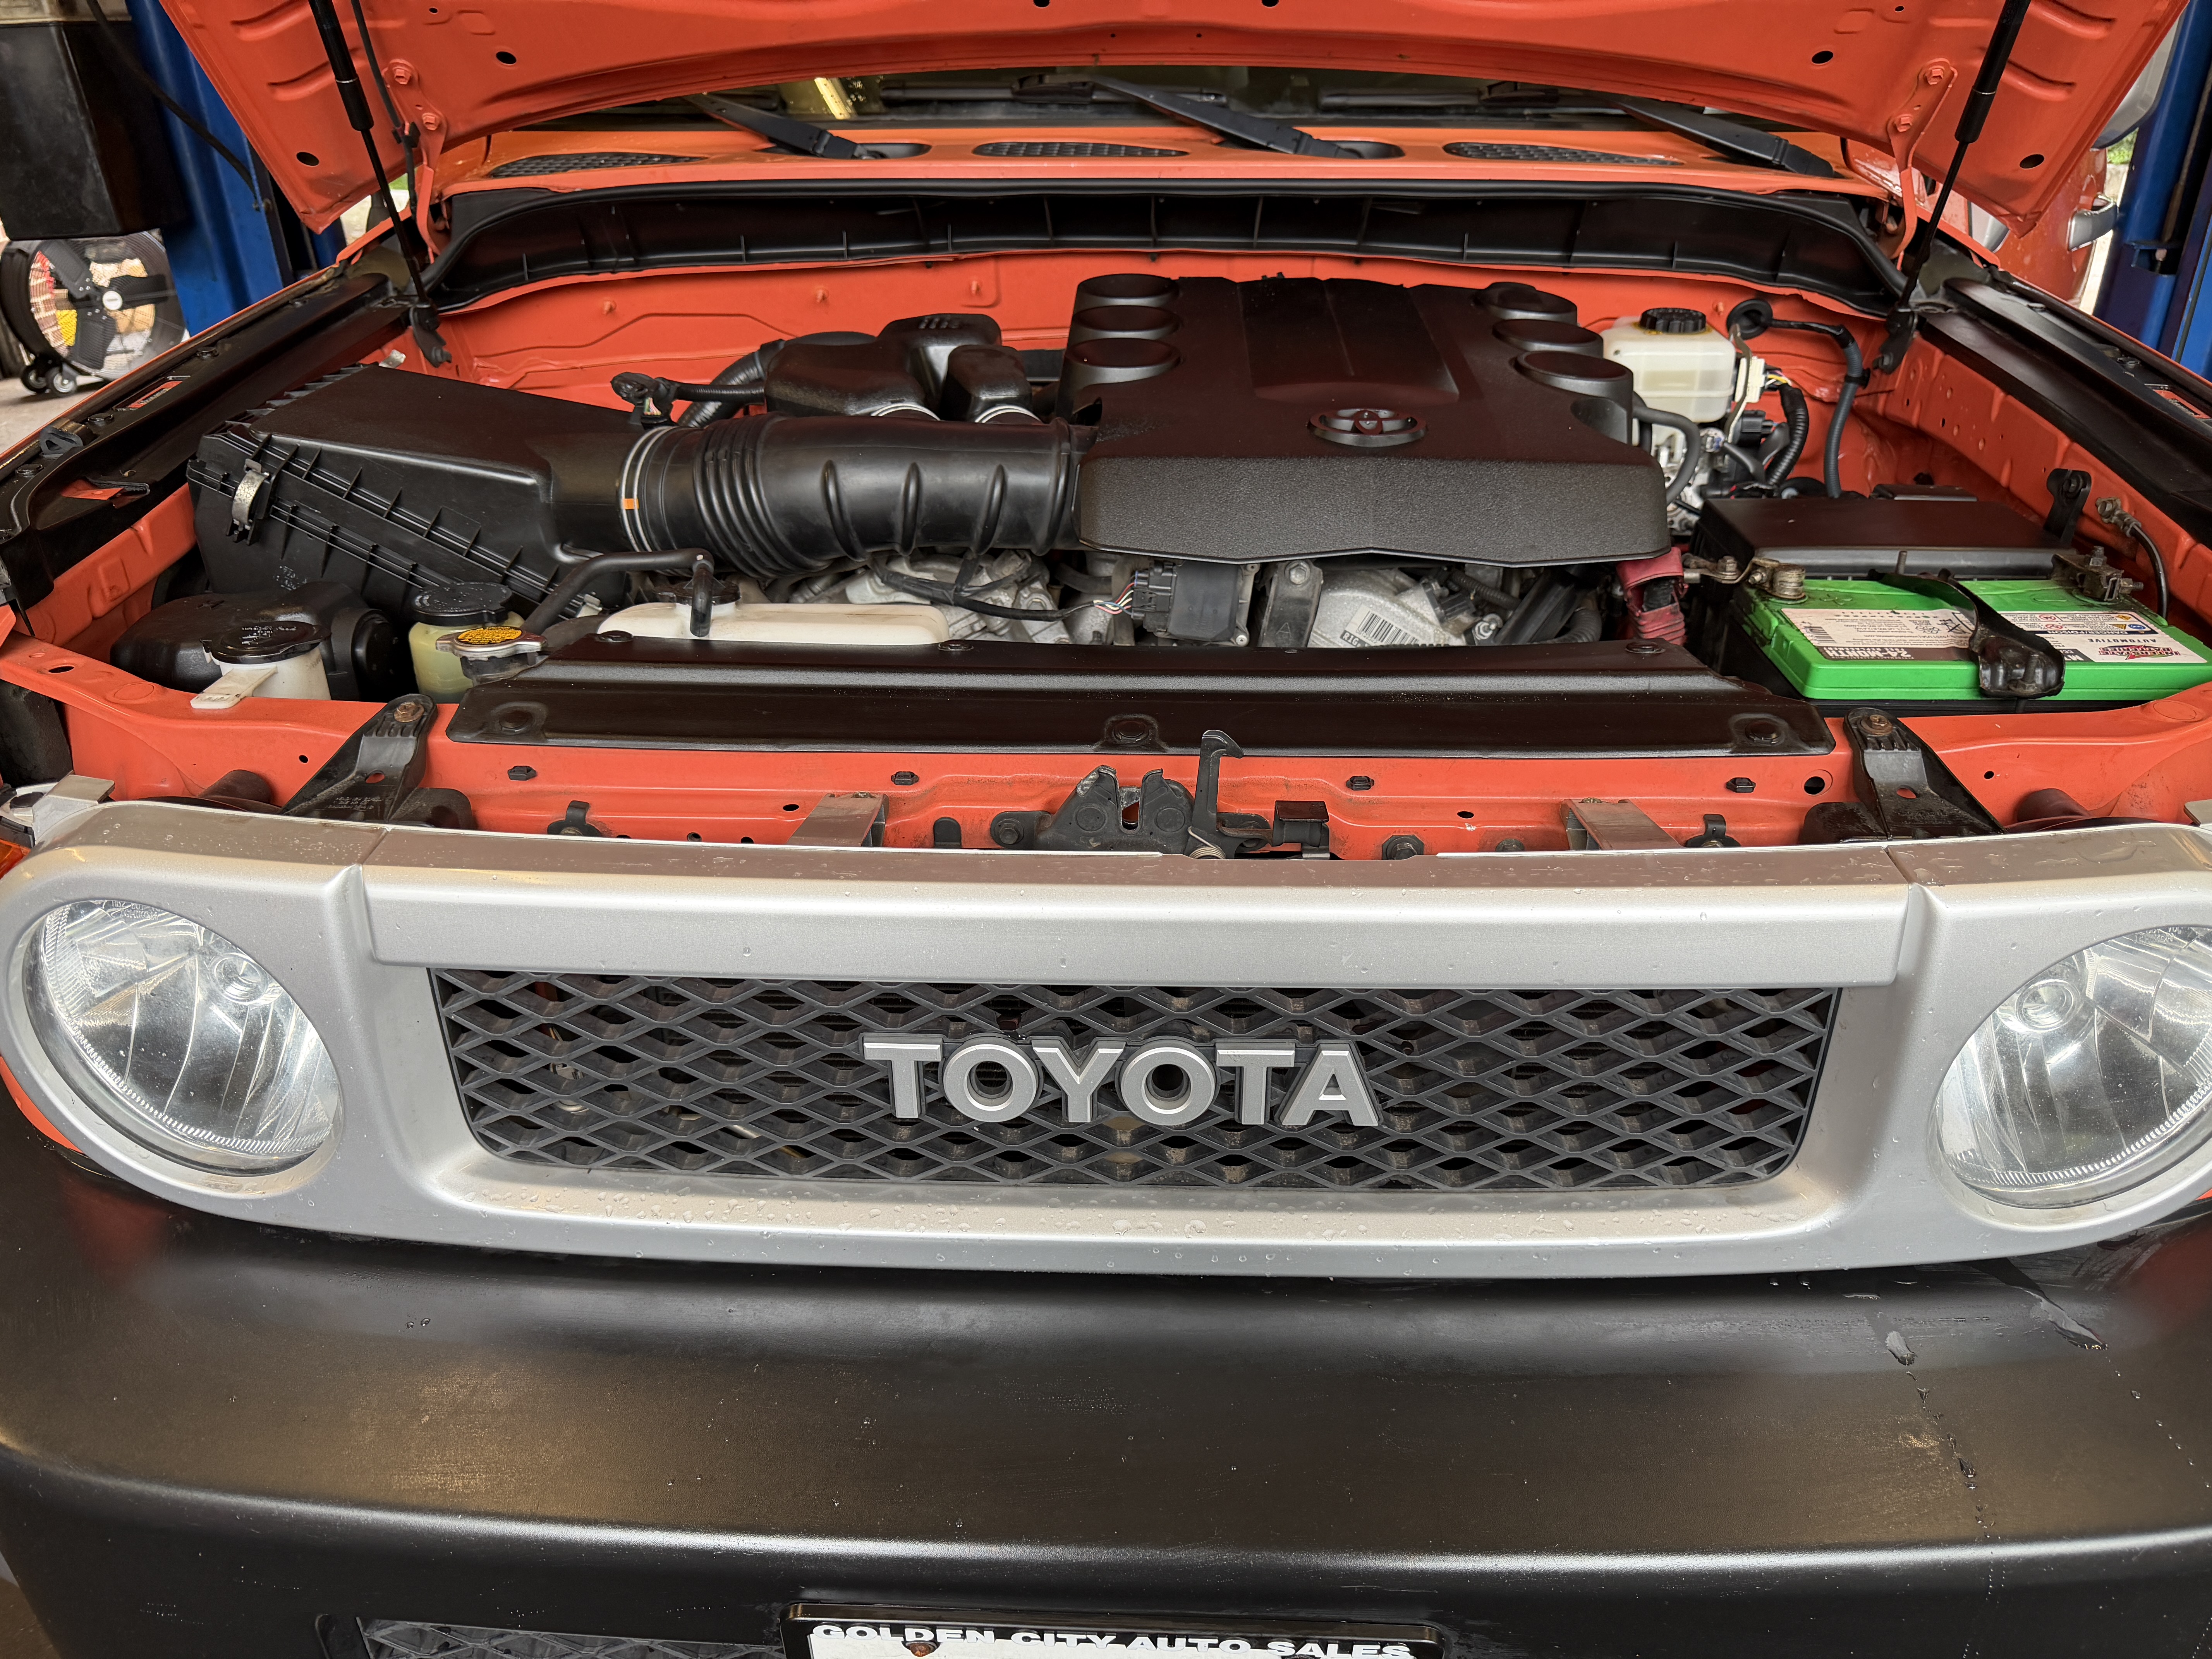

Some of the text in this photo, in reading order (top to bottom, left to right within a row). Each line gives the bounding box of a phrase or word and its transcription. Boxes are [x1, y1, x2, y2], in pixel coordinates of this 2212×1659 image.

[863, 1042, 1381, 1126] TOYOTA
[812, 1624, 1412, 1659] GOLDEN CITY AUTO SALES
